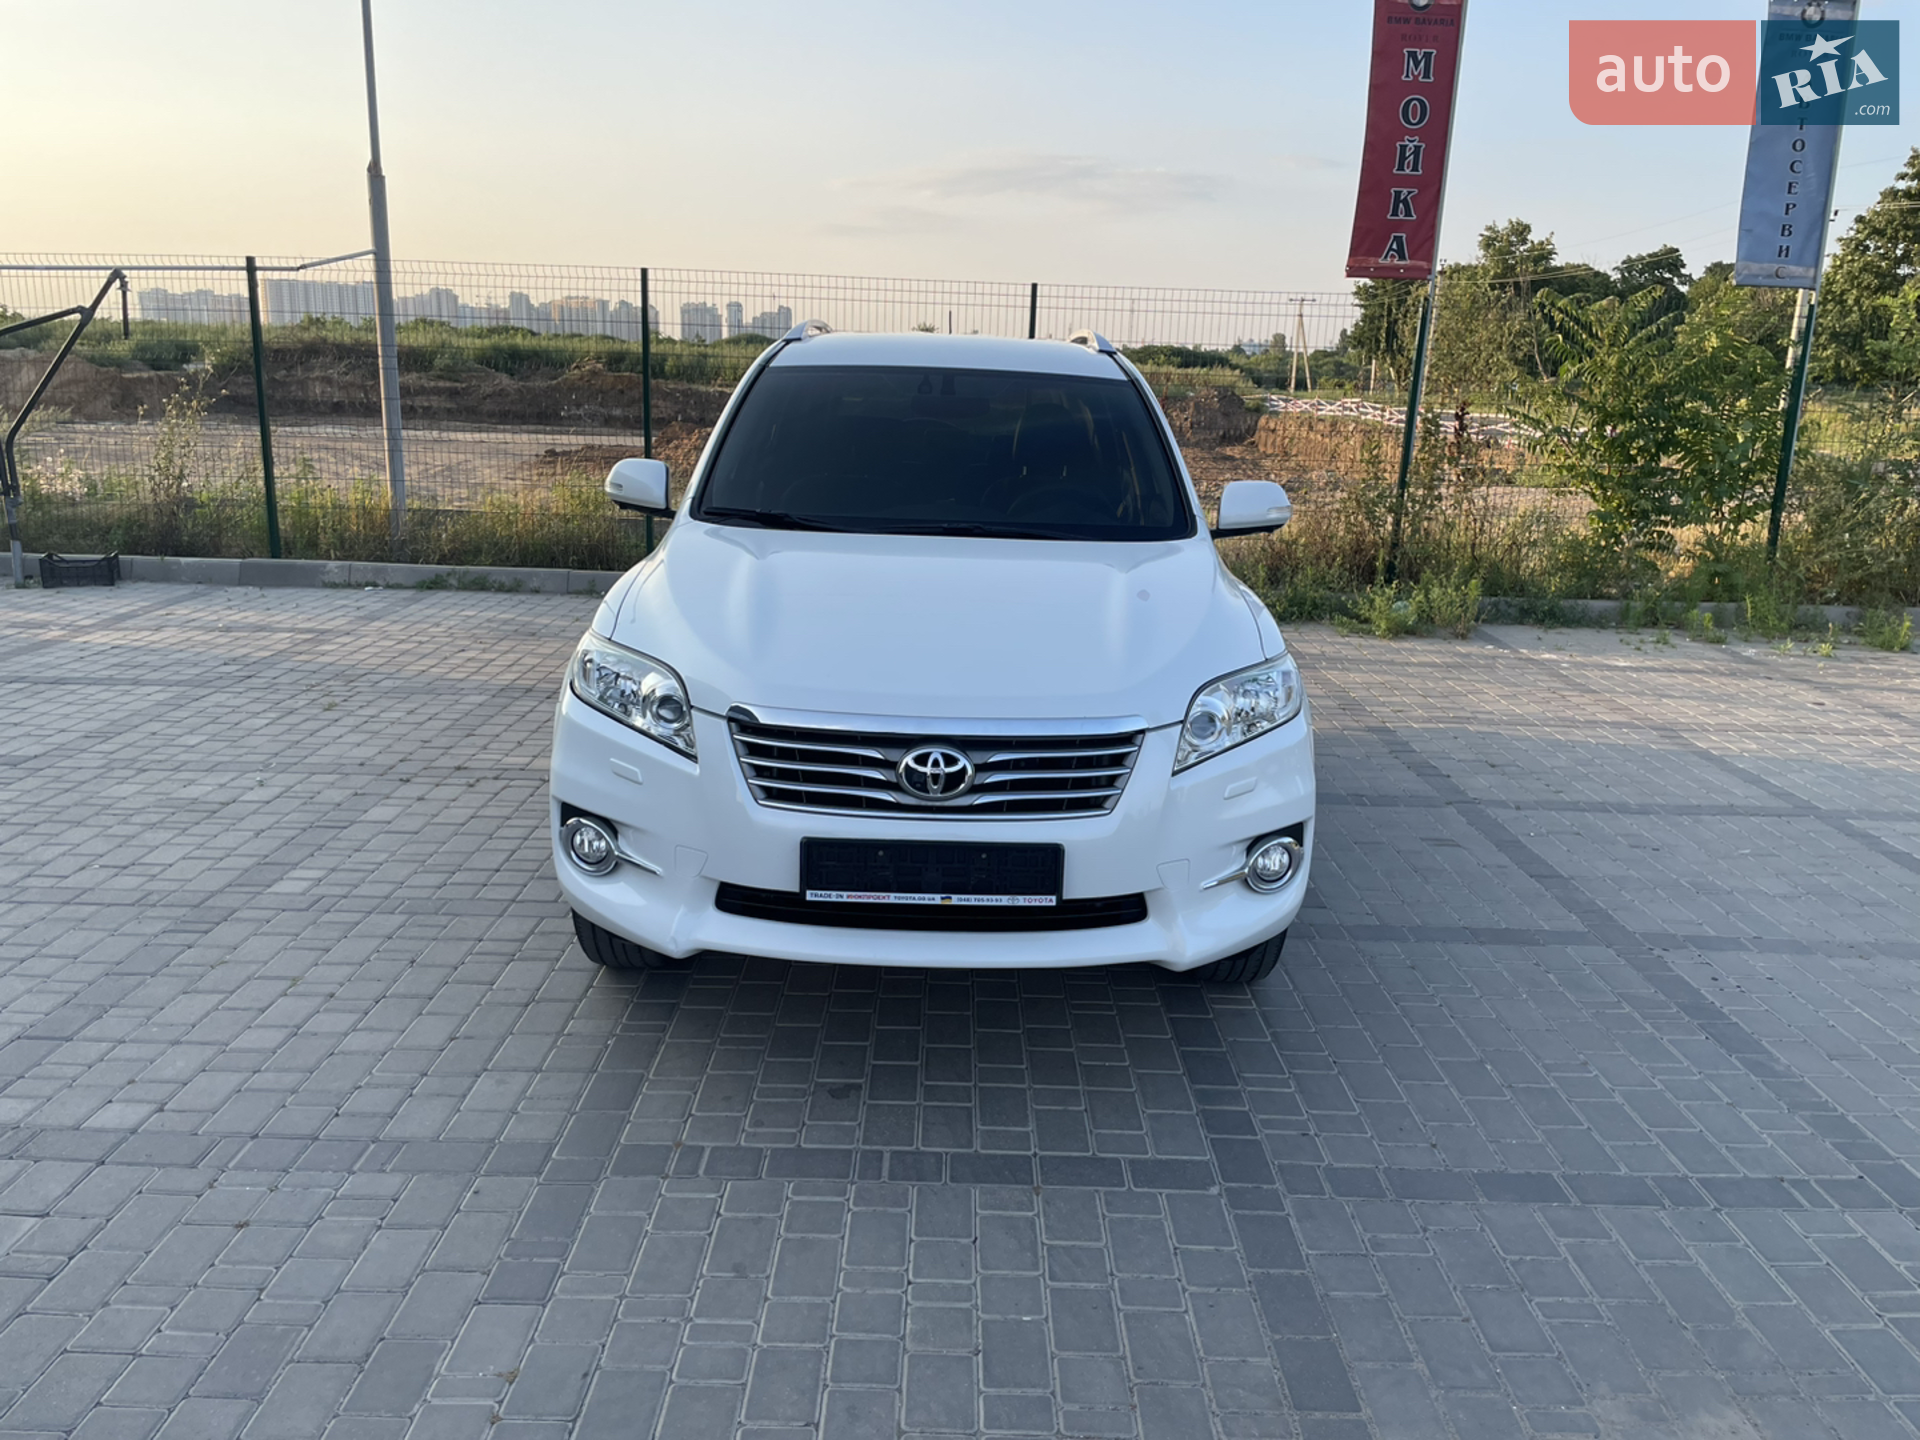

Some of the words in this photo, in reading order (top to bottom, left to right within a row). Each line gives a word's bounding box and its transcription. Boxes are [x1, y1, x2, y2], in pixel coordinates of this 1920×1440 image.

[1387, 16, 1412, 25] BMW
[1415, 17, 1455, 27] BAVARIA
[1379, 48, 1436, 264] МОЙКА
[1774, 79, 1810, 280] ТОСЕРВИС
[809, 892, 844, 900] TRADE-IN
